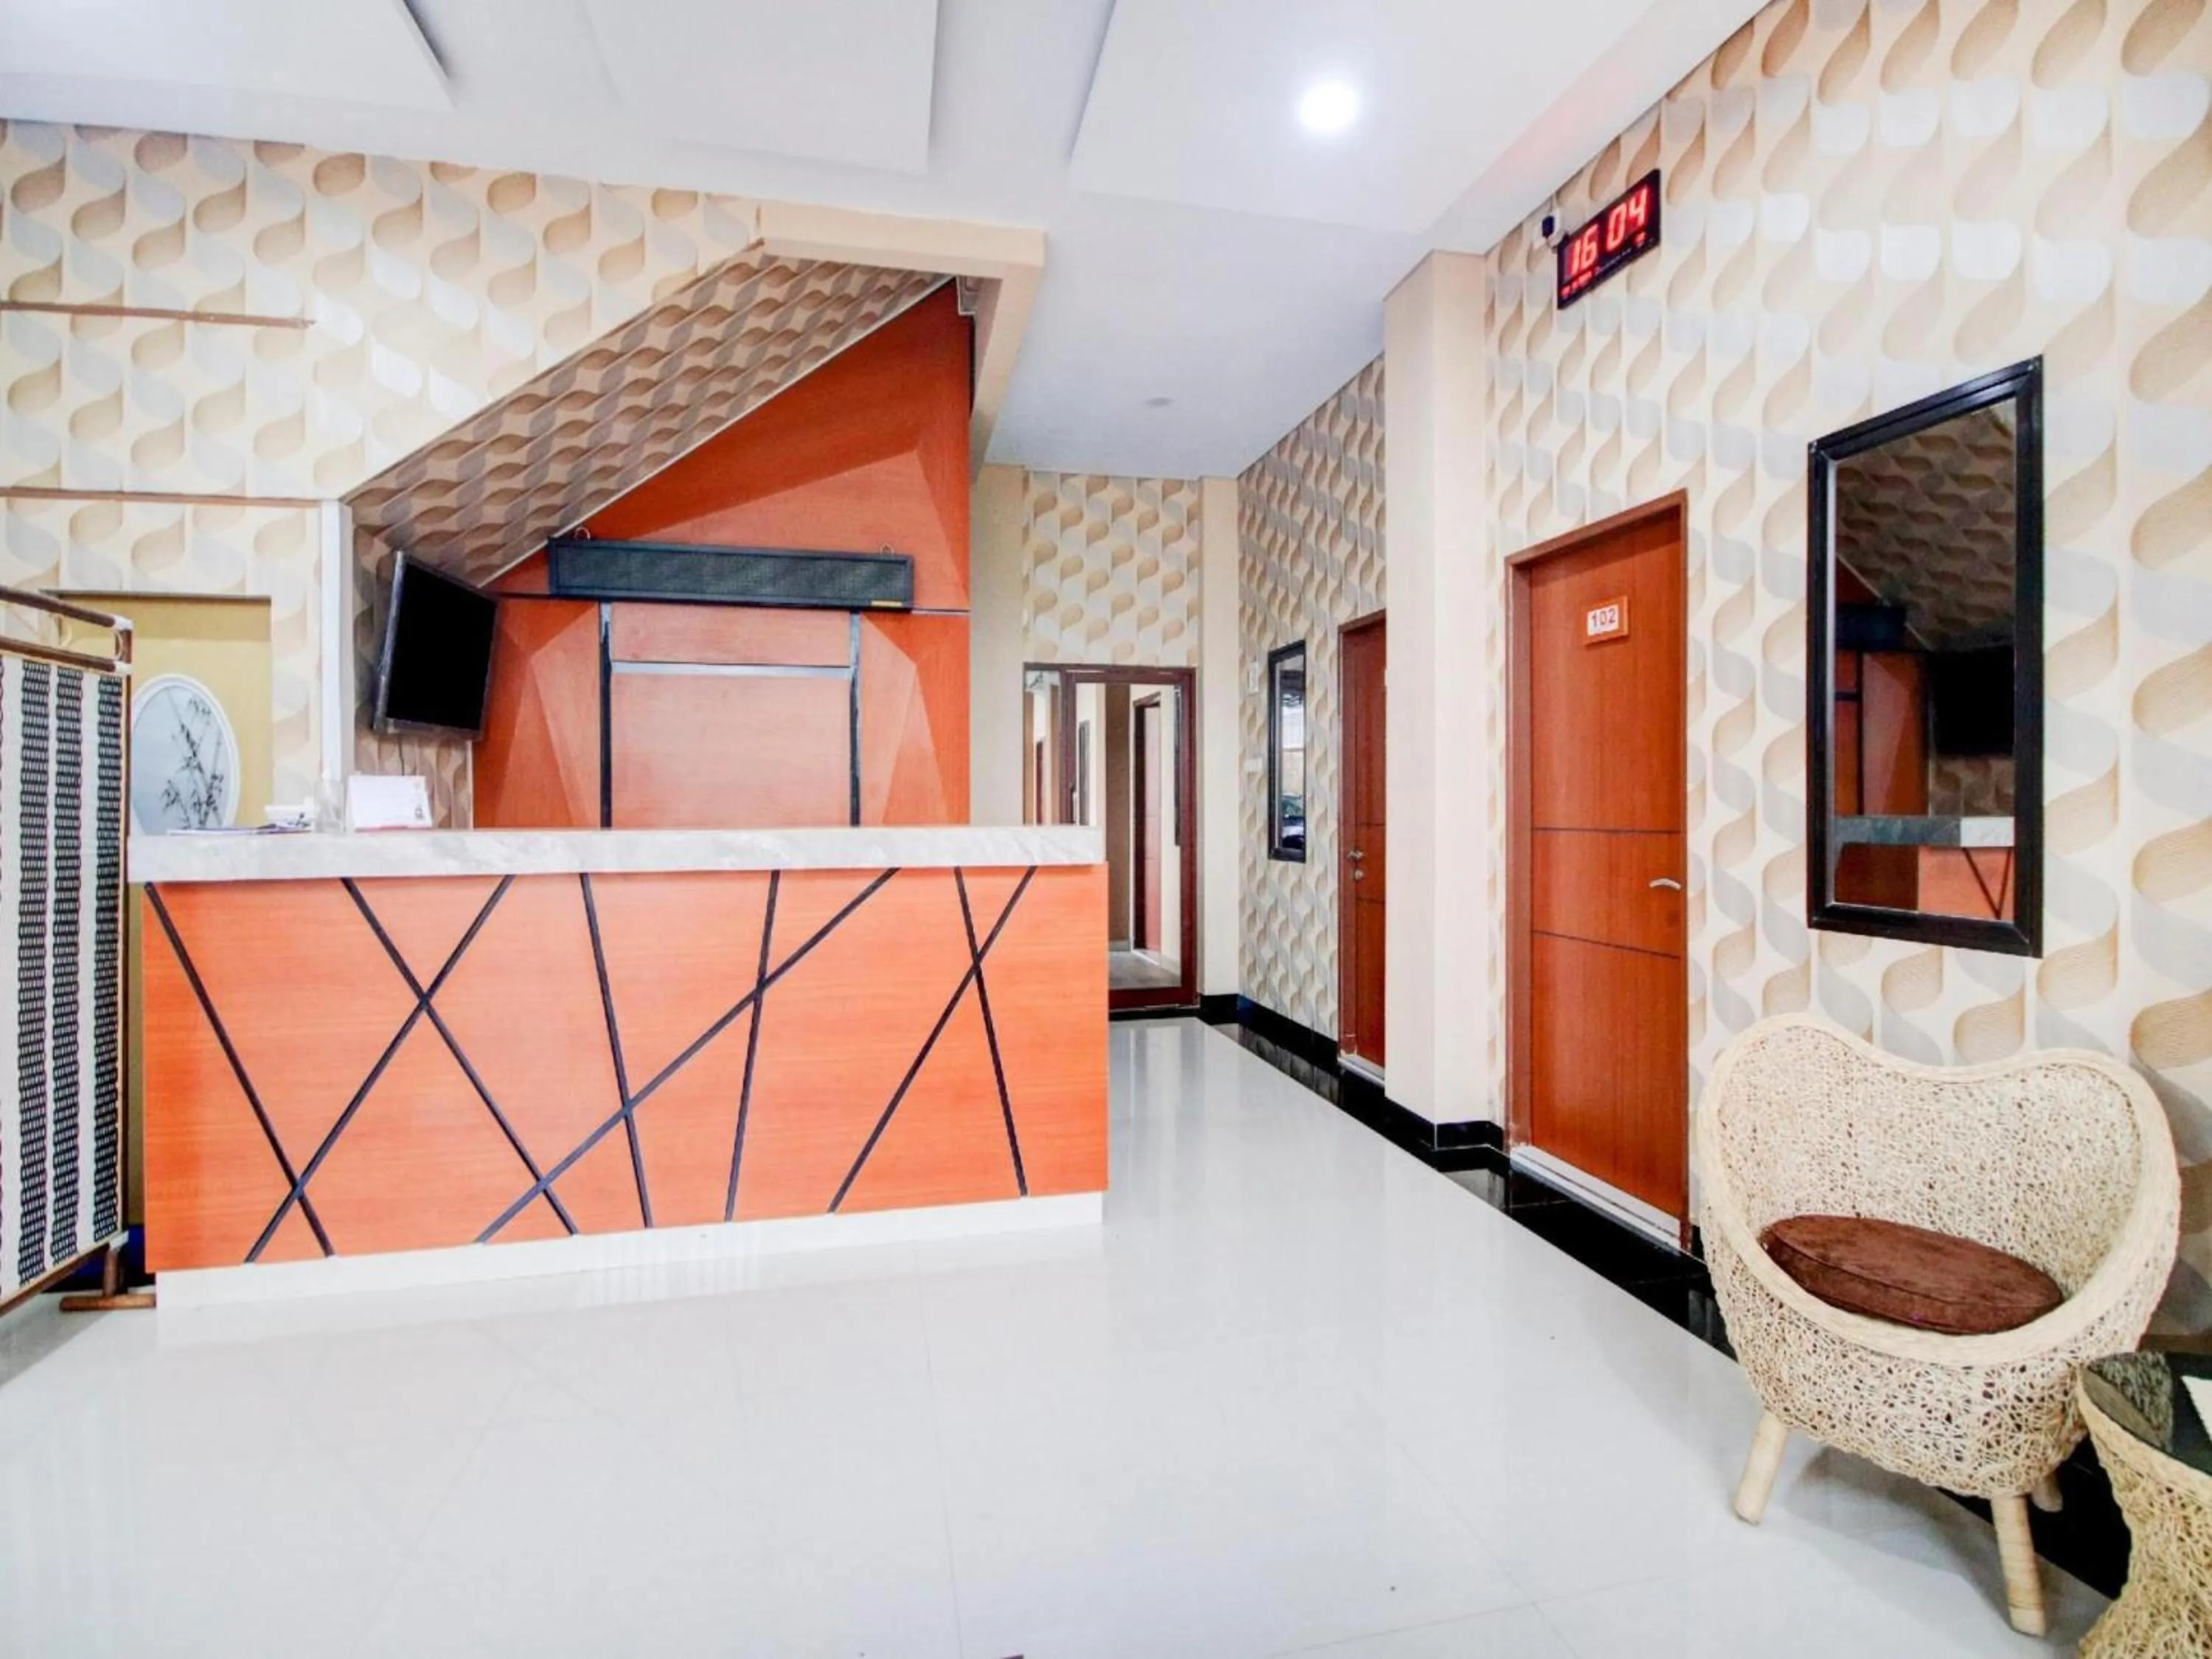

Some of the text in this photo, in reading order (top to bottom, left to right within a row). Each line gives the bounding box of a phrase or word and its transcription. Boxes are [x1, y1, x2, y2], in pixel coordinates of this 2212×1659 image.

[1571, 185, 1649, 276] 16 04
[1591, 608, 1616, 627] 102
